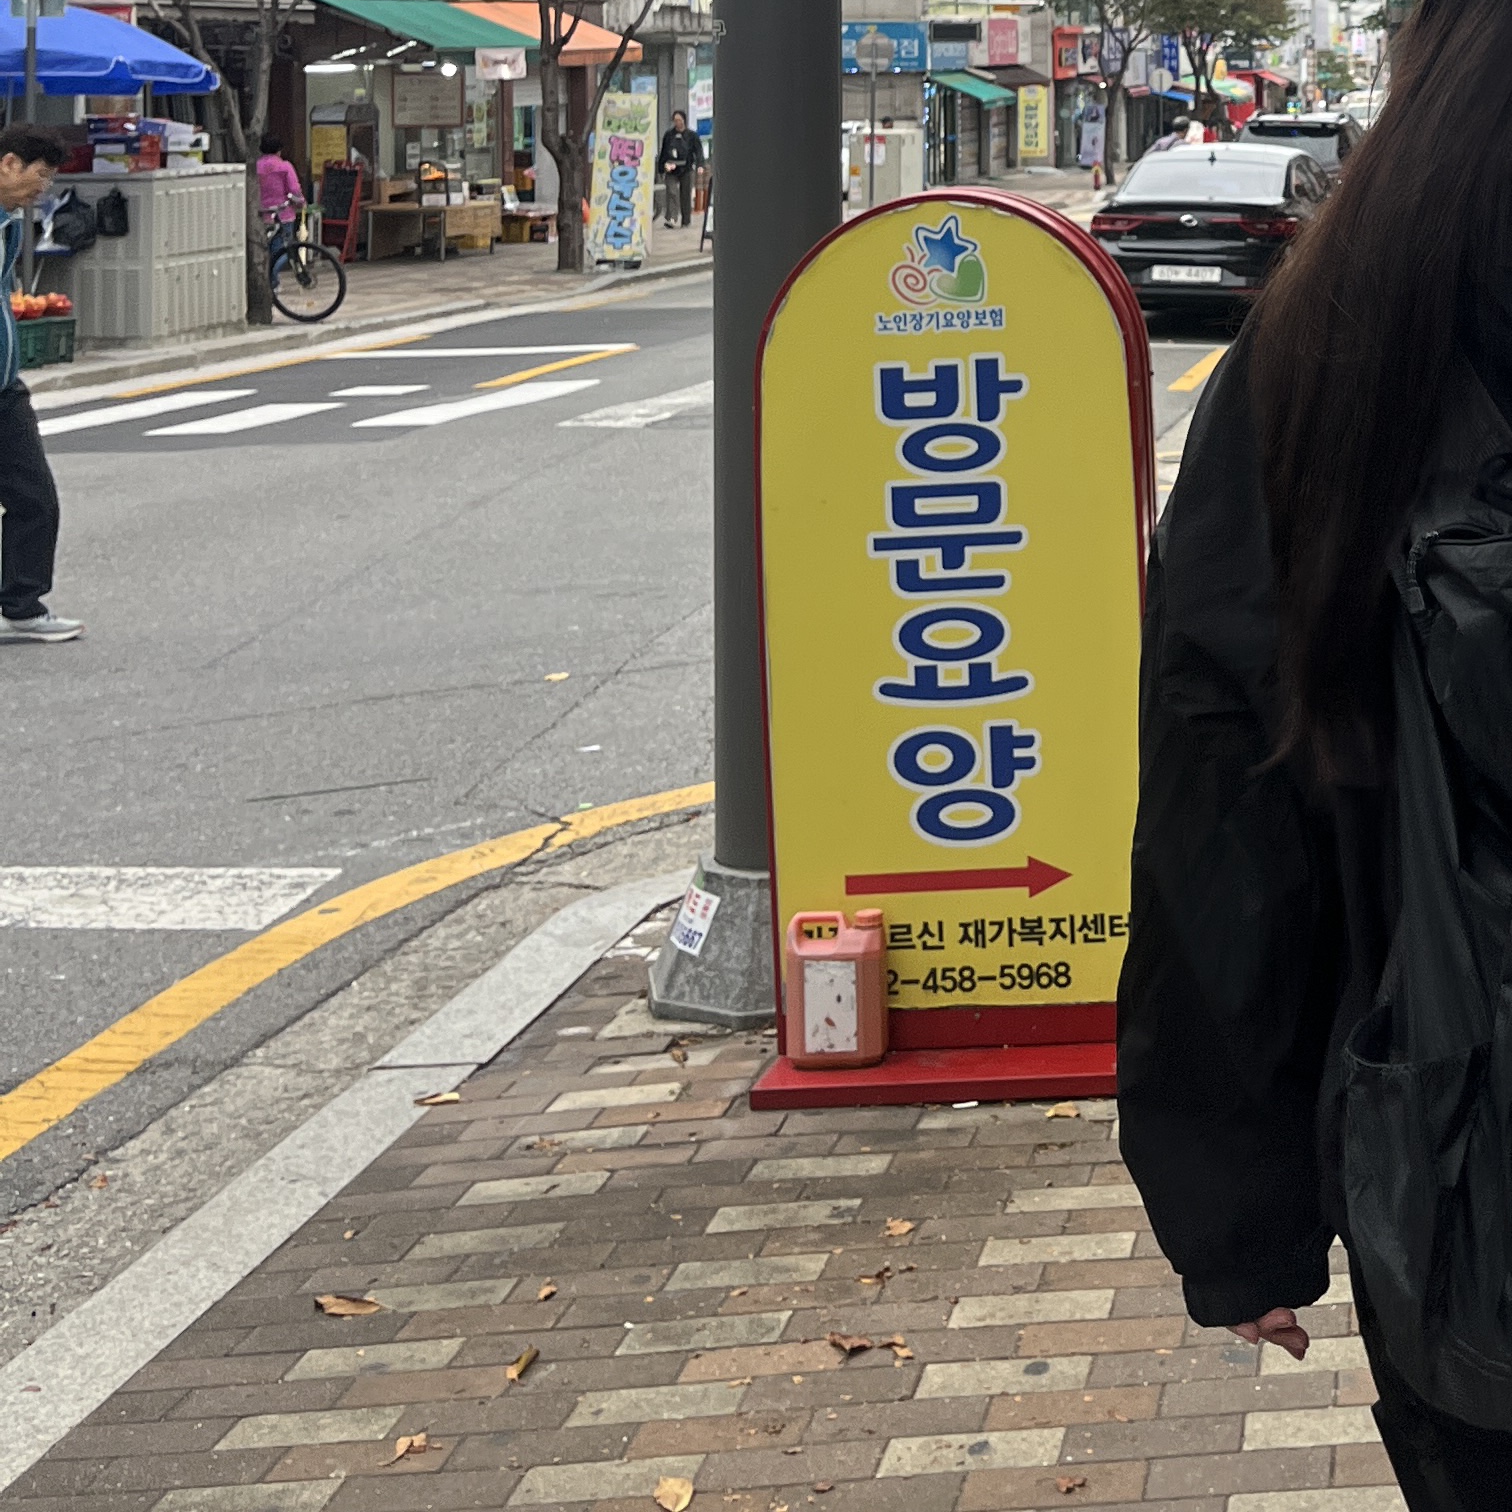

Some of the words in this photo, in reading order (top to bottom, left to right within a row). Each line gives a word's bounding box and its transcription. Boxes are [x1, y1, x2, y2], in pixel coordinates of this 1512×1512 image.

[877, 307, 1004, 333] 노인장기요양보험
[870, 357, 1038, 843] 방문요양
[886, 920, 946, 952] 르신
[958, 911, 1133, 950] 재가복지센터
[886, 961, 1072, 997] 2-458-5968
